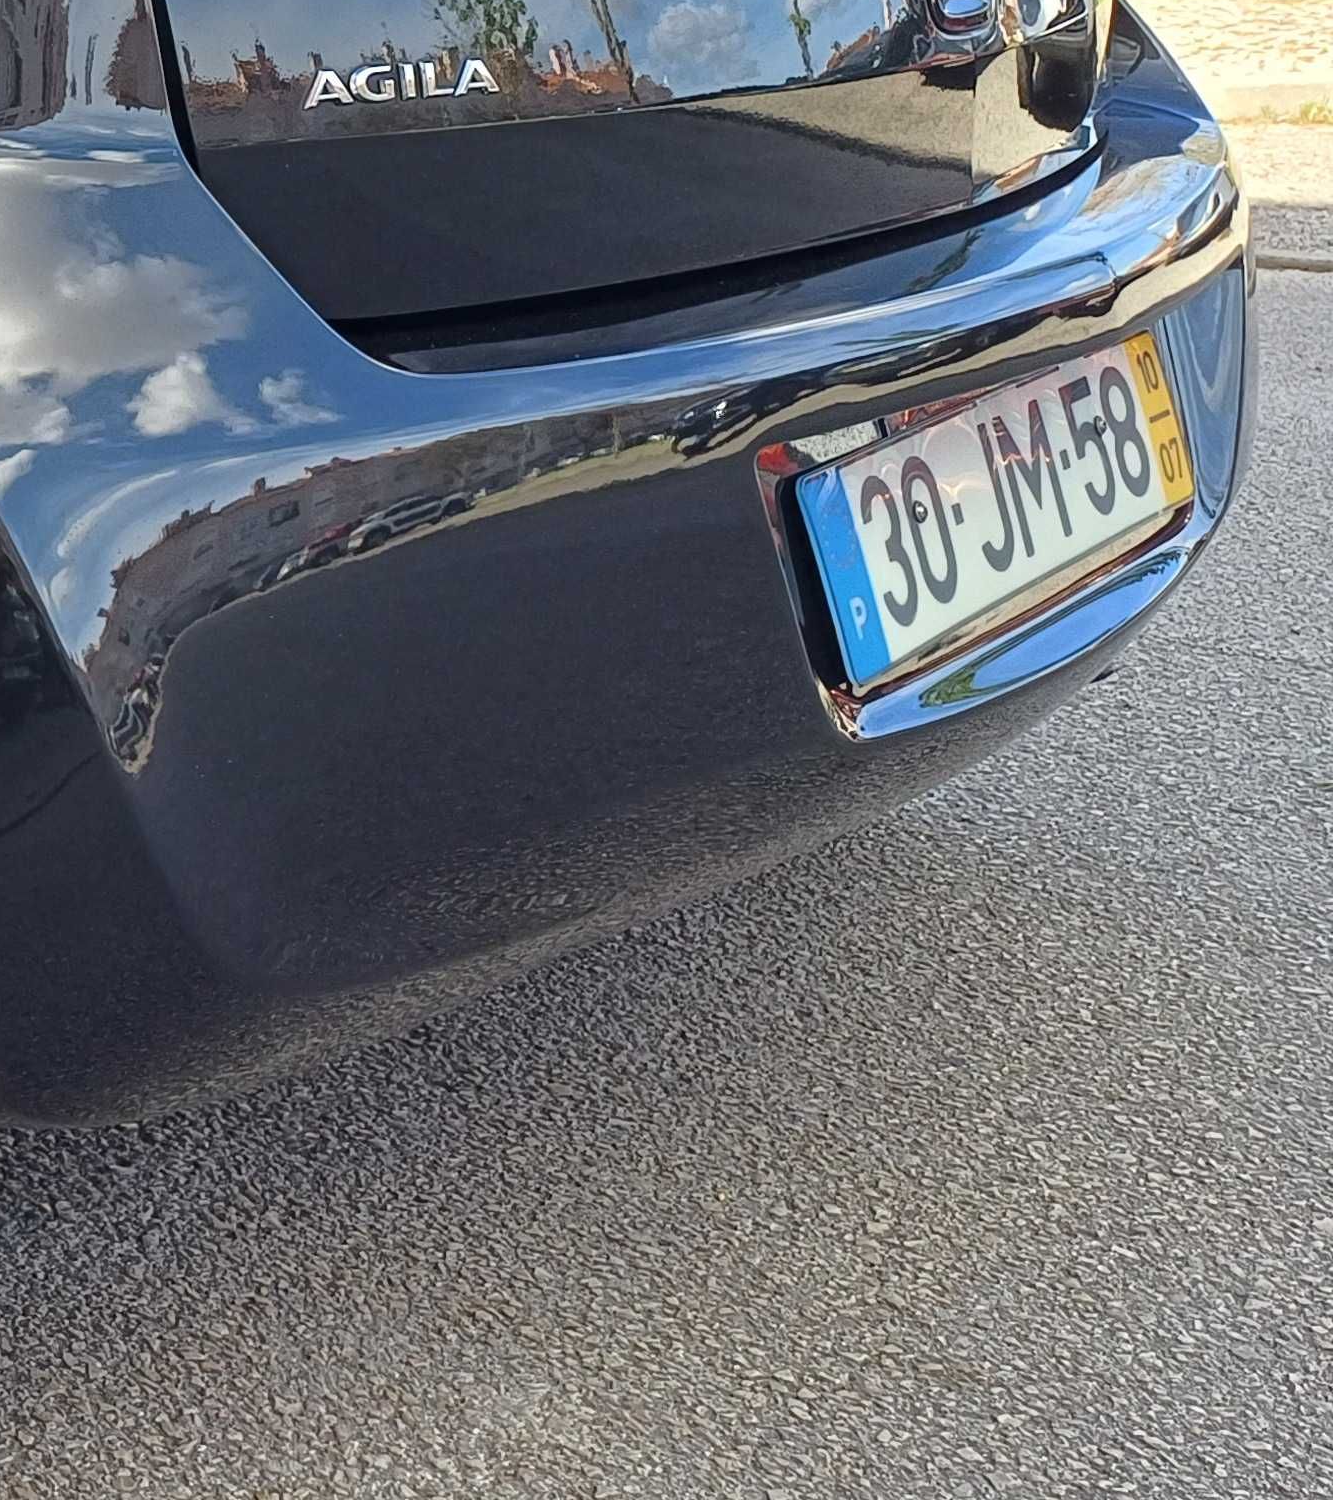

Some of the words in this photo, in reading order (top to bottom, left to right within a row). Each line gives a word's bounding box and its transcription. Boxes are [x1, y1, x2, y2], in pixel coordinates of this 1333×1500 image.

[303, 57, 500, 111] AGILA
[1134, 350, 1160, 395] 10
[1158, 436, 1185, 485] 07
[849, 596, 870, 640] P
